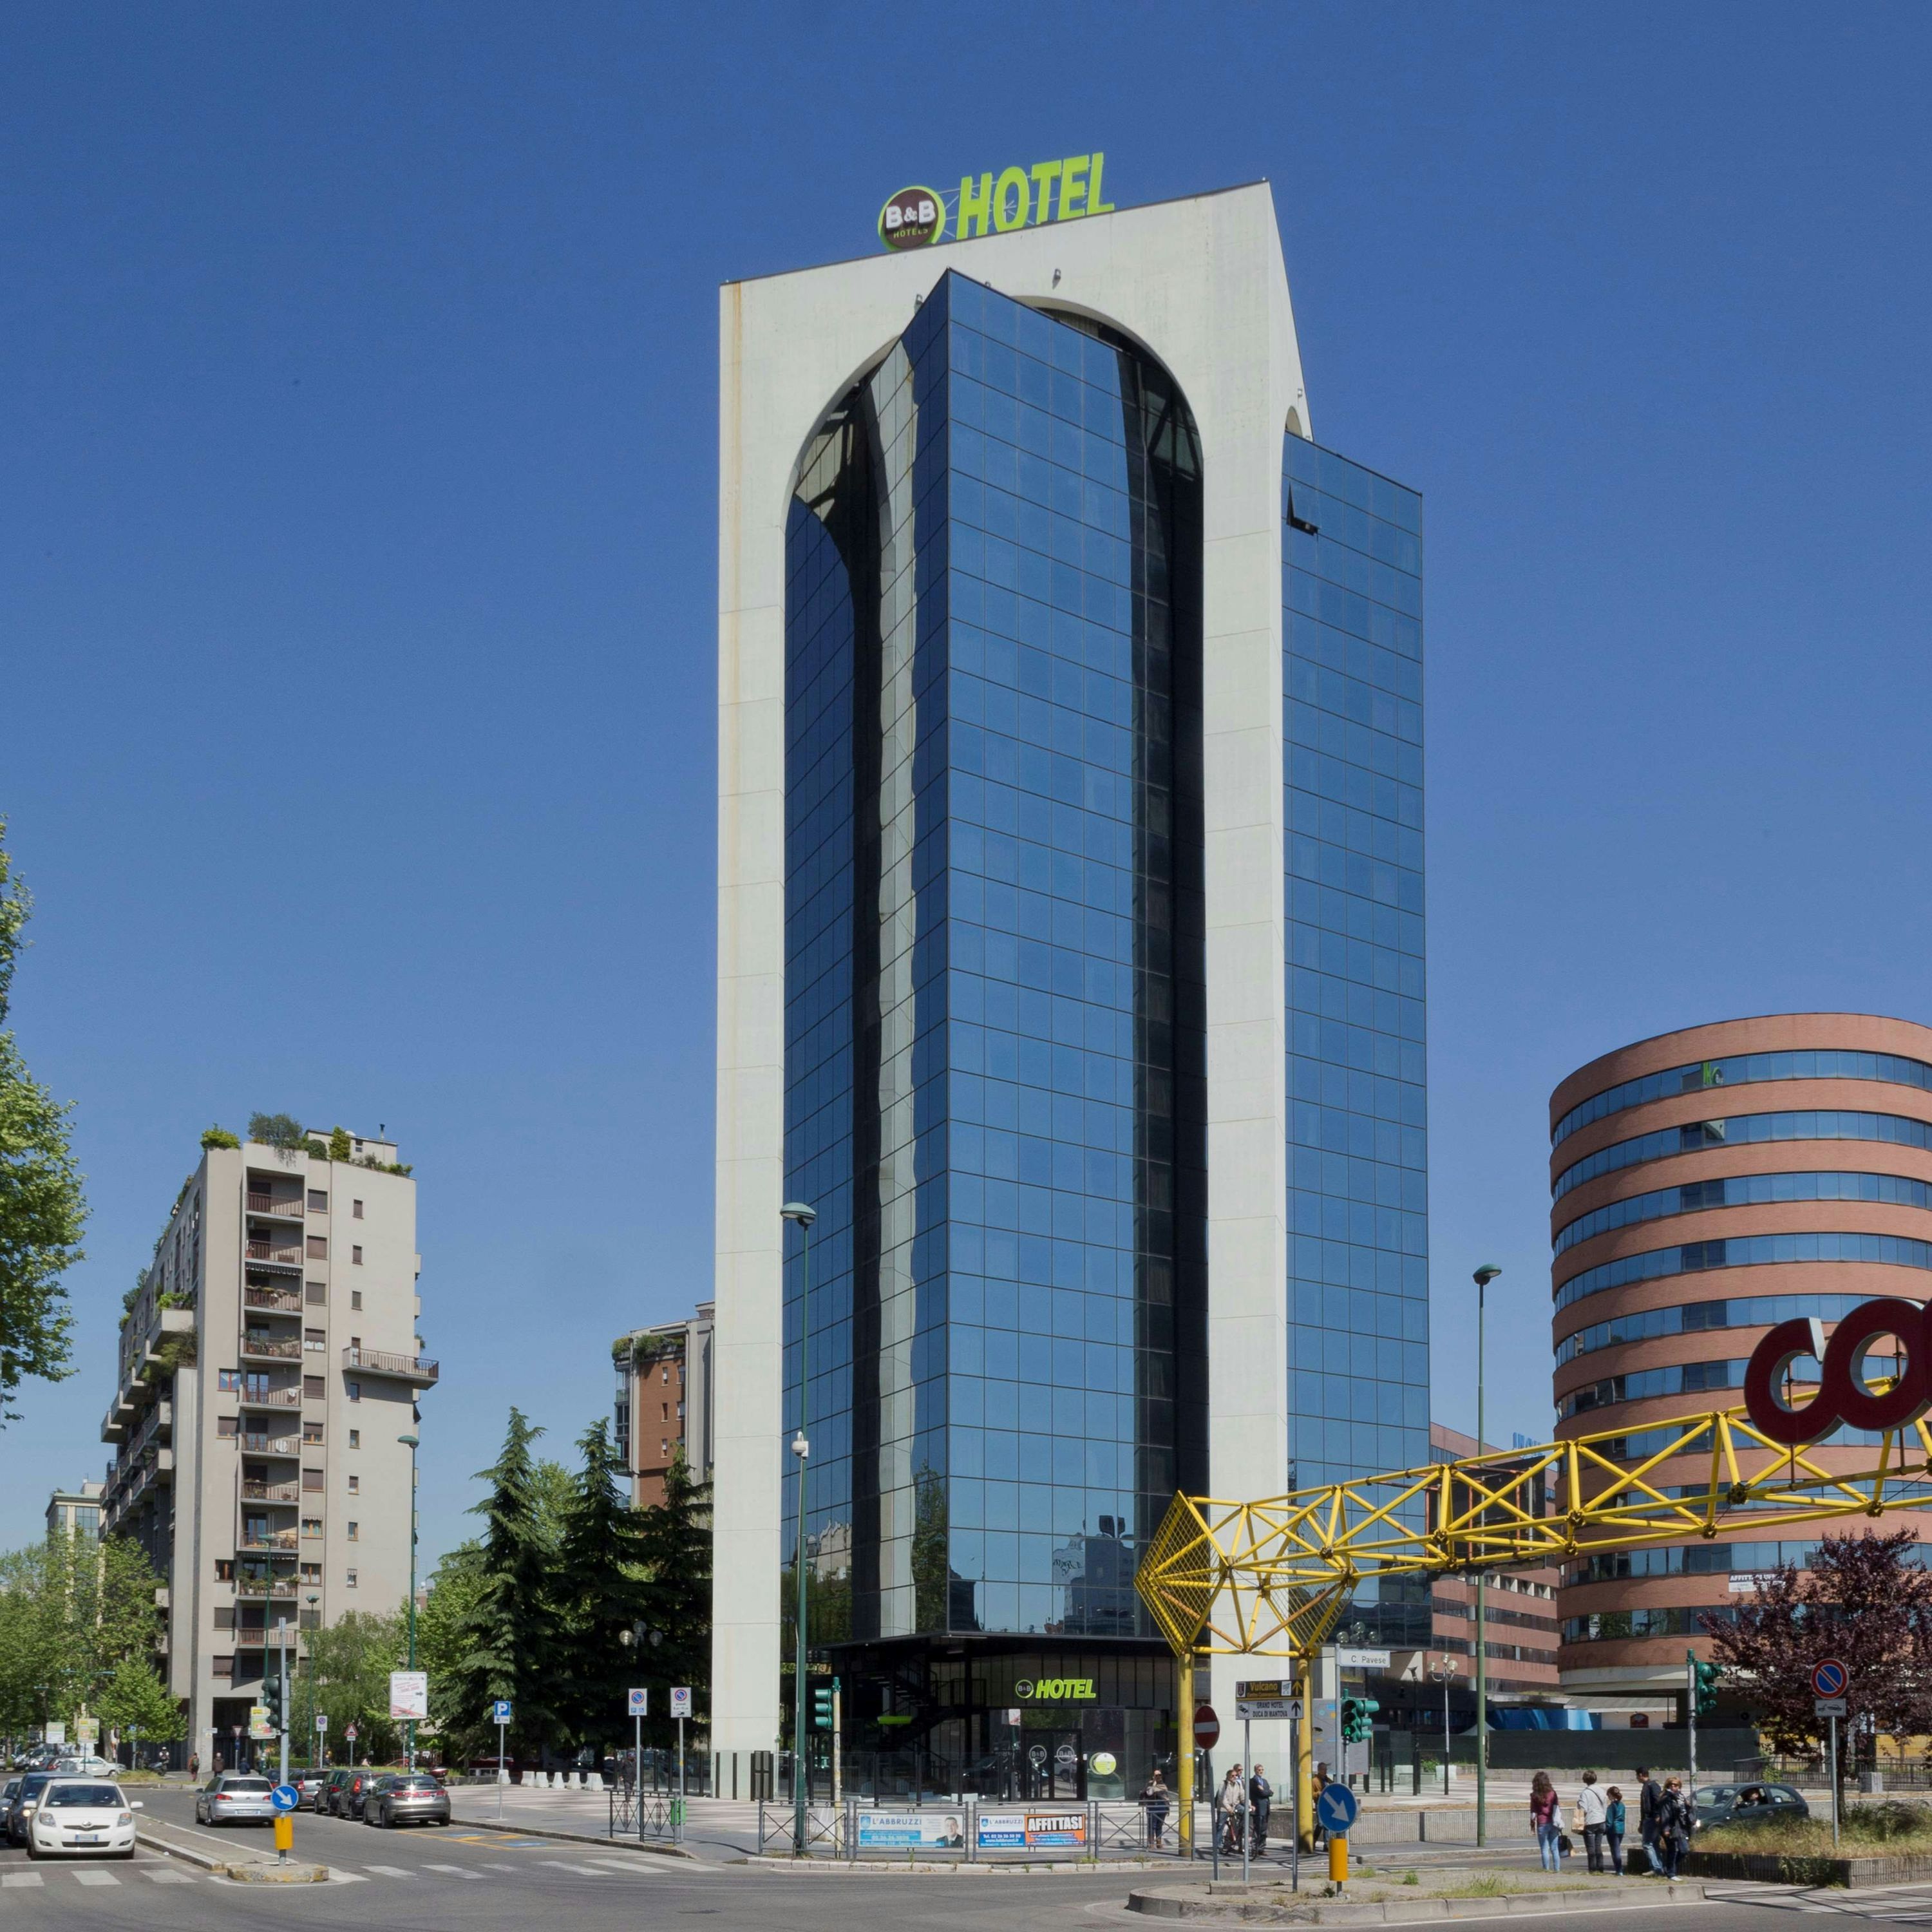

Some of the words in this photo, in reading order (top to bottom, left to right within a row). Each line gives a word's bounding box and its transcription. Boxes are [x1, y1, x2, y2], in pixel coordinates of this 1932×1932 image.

[956, 152, 1115, 240] HOTEL
[886, 200, 936, 229] B&B
[893, 228, 928, 238] HOTELS
[1361, 1656, 1387, 1664] Pavese
[1036, 1679, 1096, 1699] HOTEL
[1249, 1681, 1278, 1691] Vulcano
[1028, 1816, 1083, 1832] AFFITTASI
